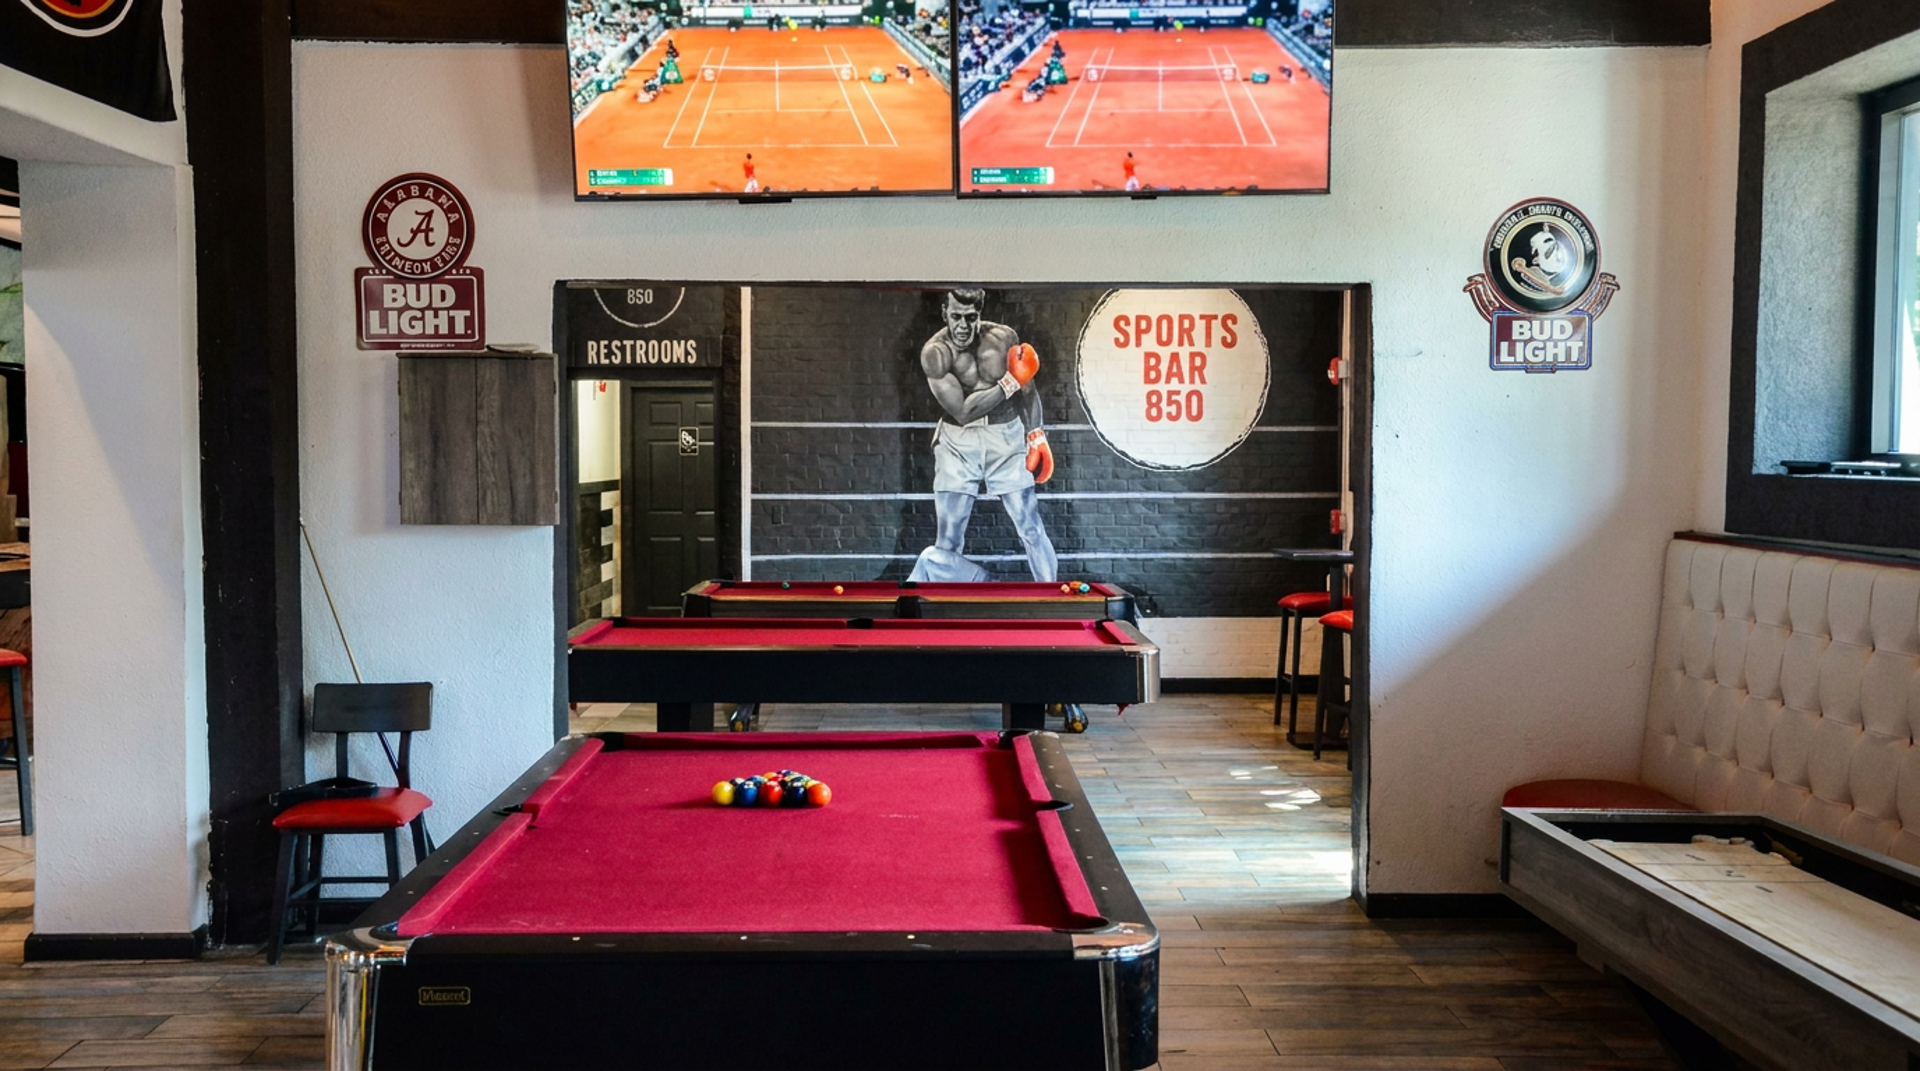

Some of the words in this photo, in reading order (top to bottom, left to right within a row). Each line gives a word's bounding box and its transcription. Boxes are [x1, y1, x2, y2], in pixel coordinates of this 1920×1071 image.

[397, 209, 435, 248] A
[383, 283, 456, 308] BUD
[627, 288, 653, 305] 850
[1113, 313, 1239, 349] SPORTS
[1512, 320, 1574, 341] BUD
[587, 339, 697, 365] RESTROOMS
[1500, 341, 1583, 363] LIGHT
[1143, 351, 1208, 385] BAR
[1145, 389, 1204, 423] 850
